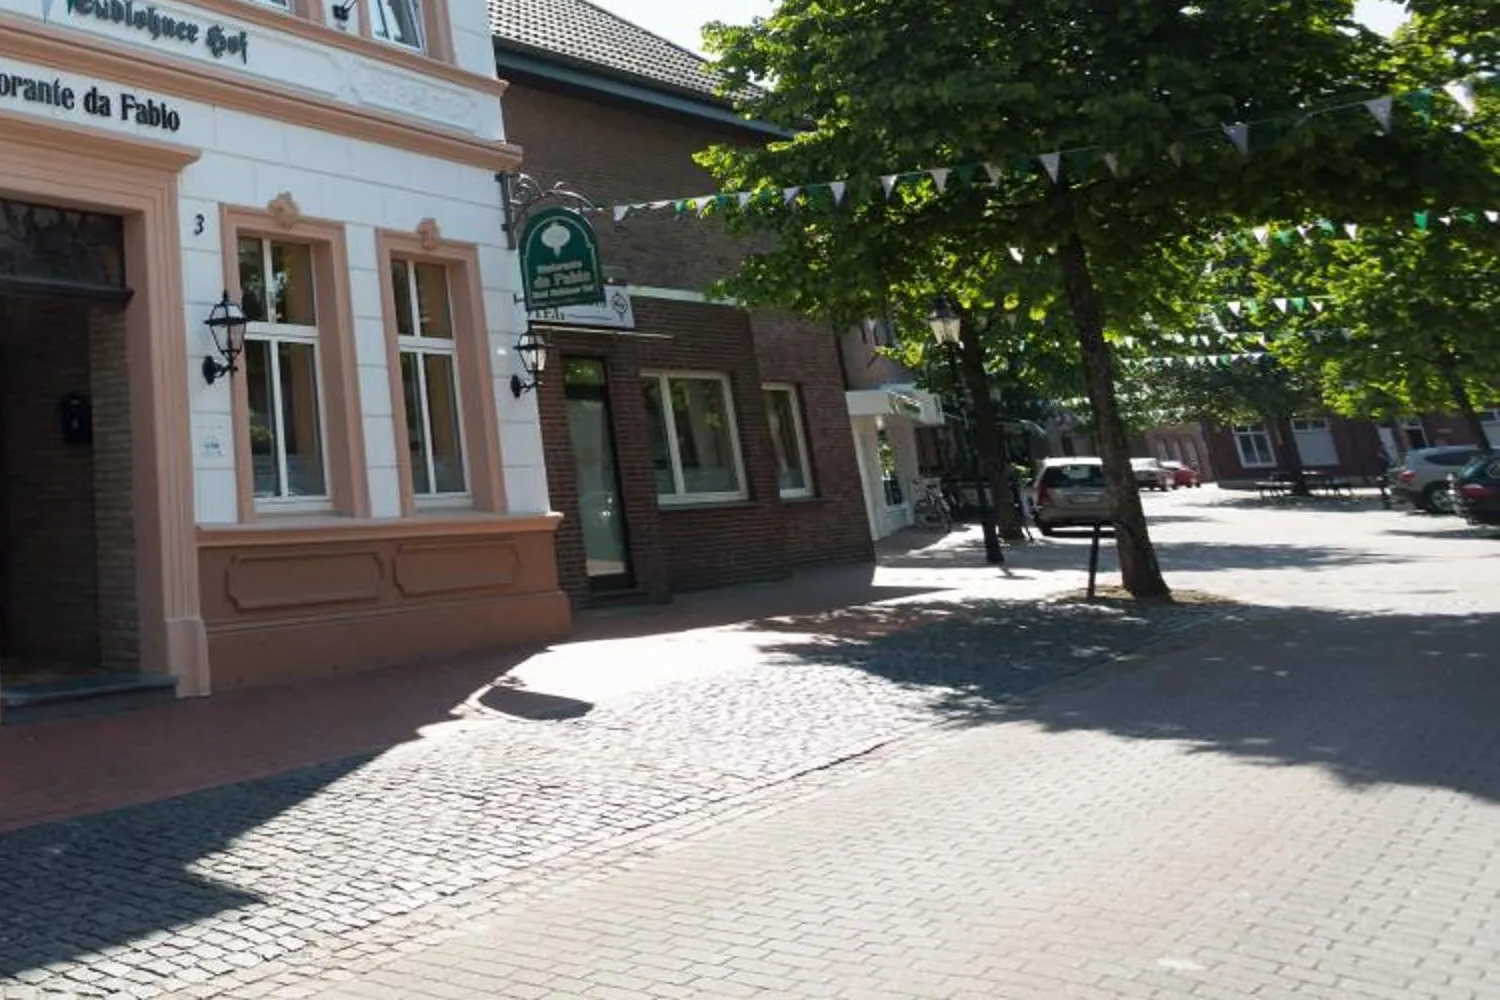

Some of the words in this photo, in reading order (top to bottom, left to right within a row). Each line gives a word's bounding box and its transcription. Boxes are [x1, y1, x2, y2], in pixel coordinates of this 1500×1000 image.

[205, 24, 248, 65] Hof
[83, 86, 112, 118] da
[120, 93, 181, 132] Fabio
[193, 213, 205, 236] 3
